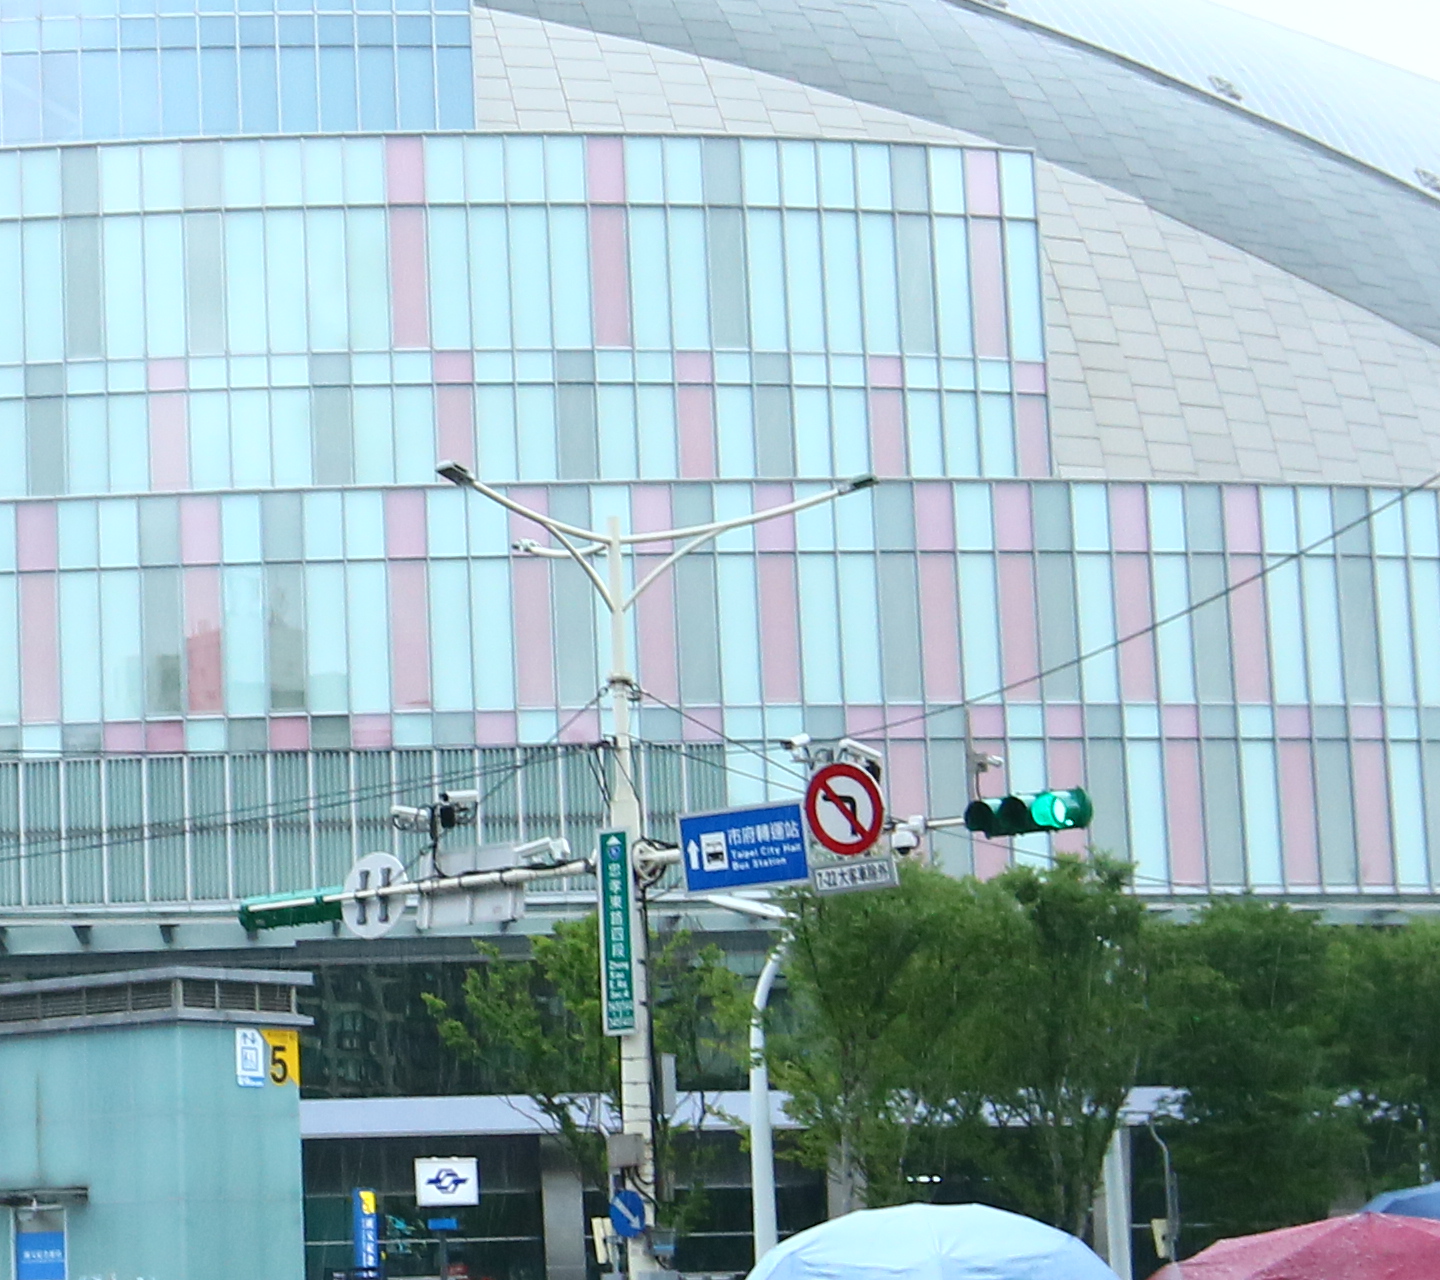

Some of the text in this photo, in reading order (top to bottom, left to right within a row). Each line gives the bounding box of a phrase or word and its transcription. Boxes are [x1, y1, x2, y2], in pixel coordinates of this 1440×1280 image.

[760, 845, 781, 856] City
[752, 857, 787, 869] Station
[270, 1045, 288, 1084] 5
